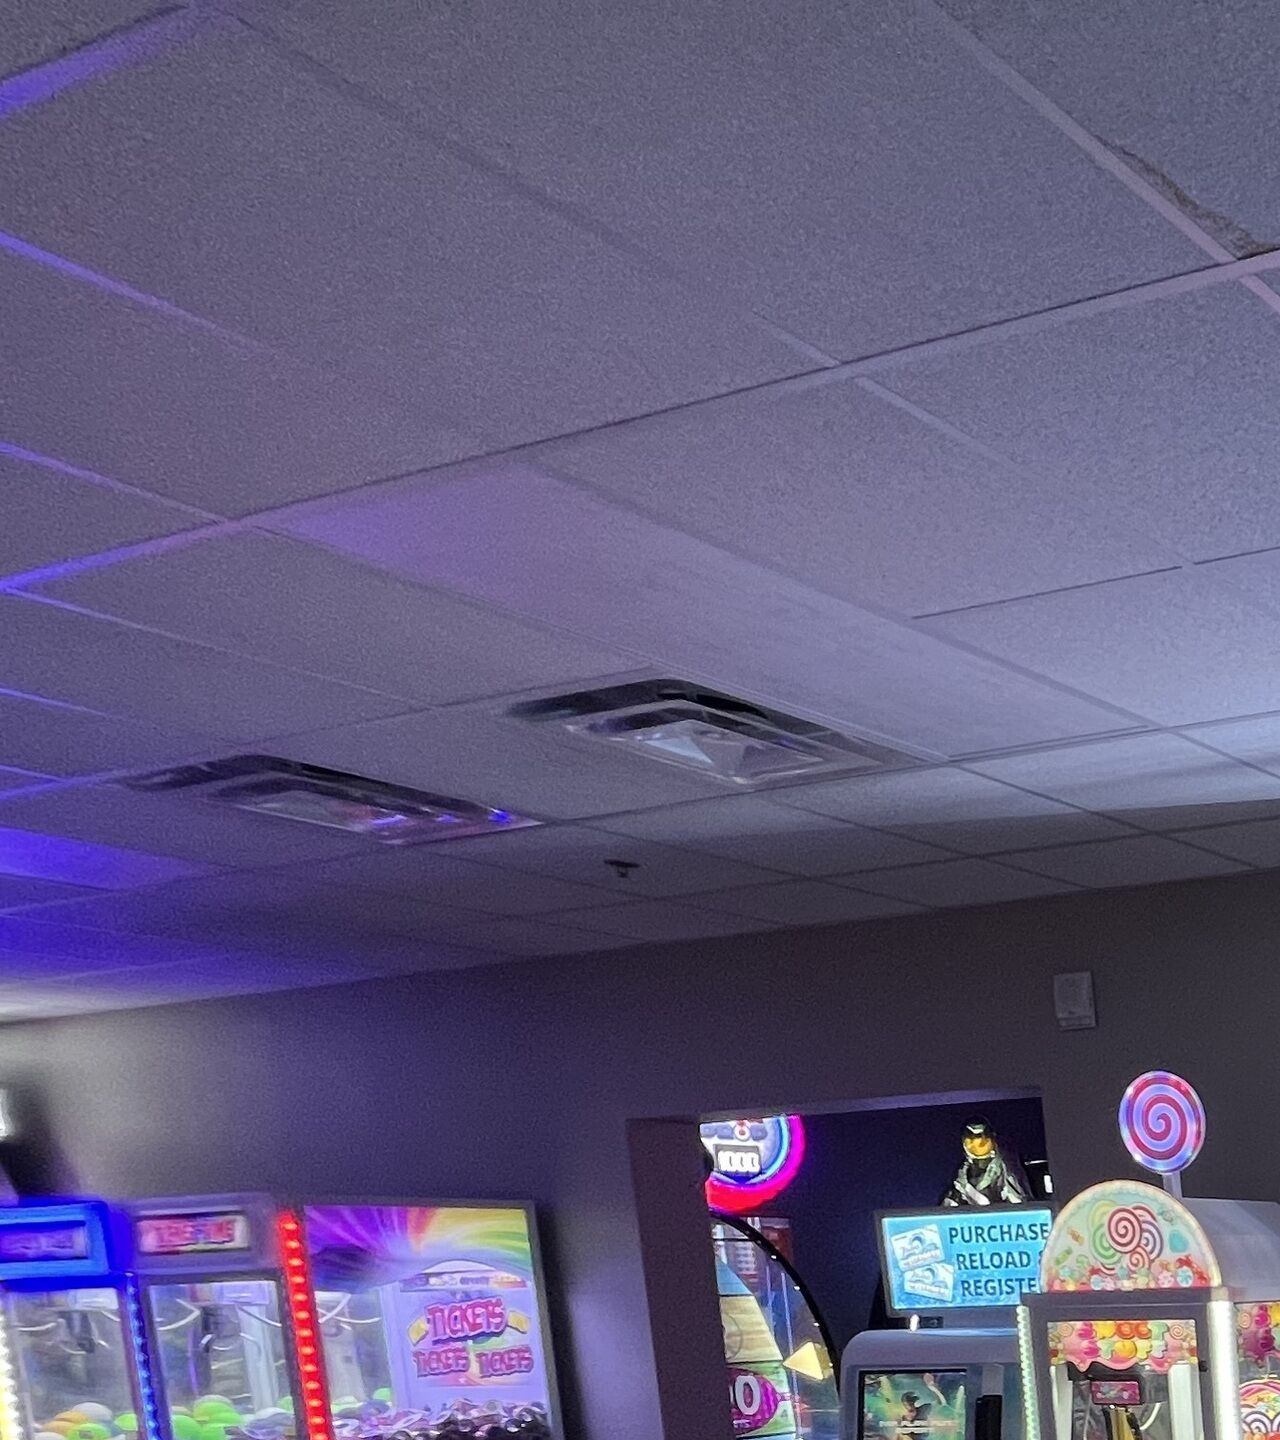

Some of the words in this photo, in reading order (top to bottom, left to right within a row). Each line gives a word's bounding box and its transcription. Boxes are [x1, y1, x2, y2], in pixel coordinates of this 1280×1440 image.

[718, 1151, 760, 1172] 1000
[949, 1223, 1049, 1244] PURCHASE
[956, 1252, 1031, 1271] RELOAD
[961, 1278, 1036, 1297] REGISTE
[427, 1299, 506, 1342] TICKETS
[413, 1347, 470, 1377] TICKETS
[476, 1346, 533, 1377] TICKETS
